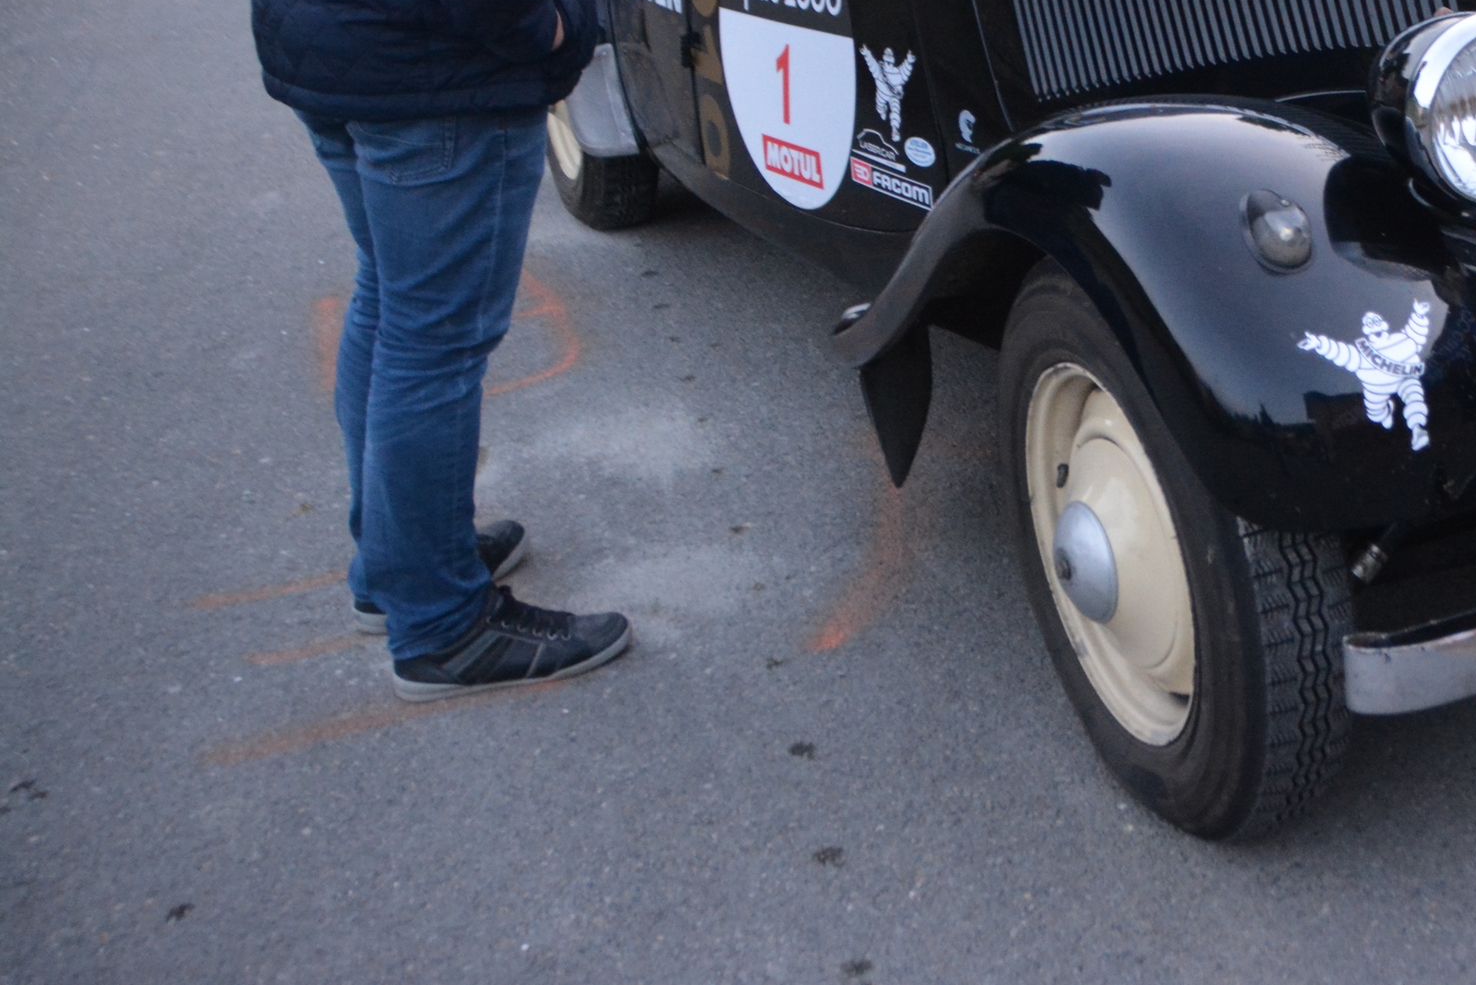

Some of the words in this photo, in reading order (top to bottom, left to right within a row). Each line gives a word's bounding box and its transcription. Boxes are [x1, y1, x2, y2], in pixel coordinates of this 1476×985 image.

[776, 43, 791, 125] 1
[766, 139, 821, 183] MOTUL
[873, 171, 930, 205] FACOM
[1357, 340, 1424, 377] MICHELIN
